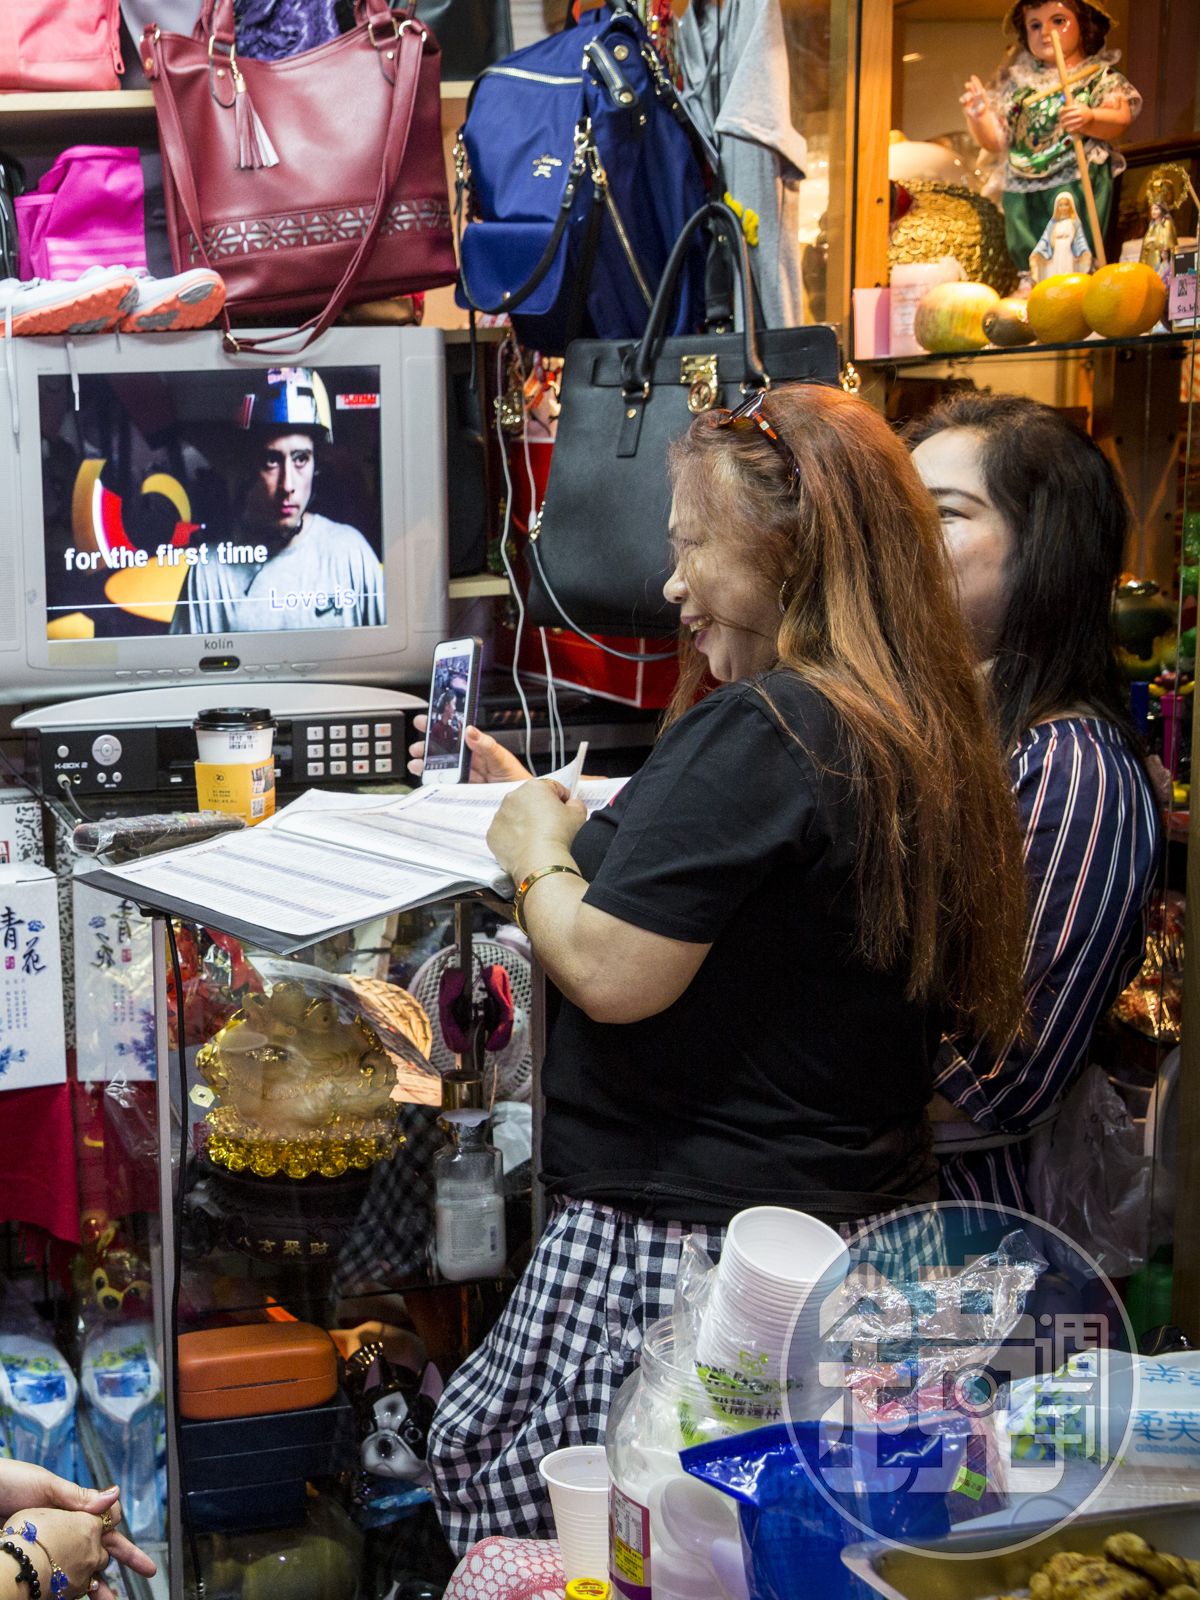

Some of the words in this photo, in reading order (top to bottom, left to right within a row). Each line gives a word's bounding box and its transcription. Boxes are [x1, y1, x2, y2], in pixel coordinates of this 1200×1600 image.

[64, 547, 101, 570] for
[109, 547, 148, 568] the
[156, 544, 208, 566] first
[217, 542, 268, 564] time
[270, 588, 327, 610] Love
[334, 586, 356, 609] is
[204, 638, 234, 650] kolin
